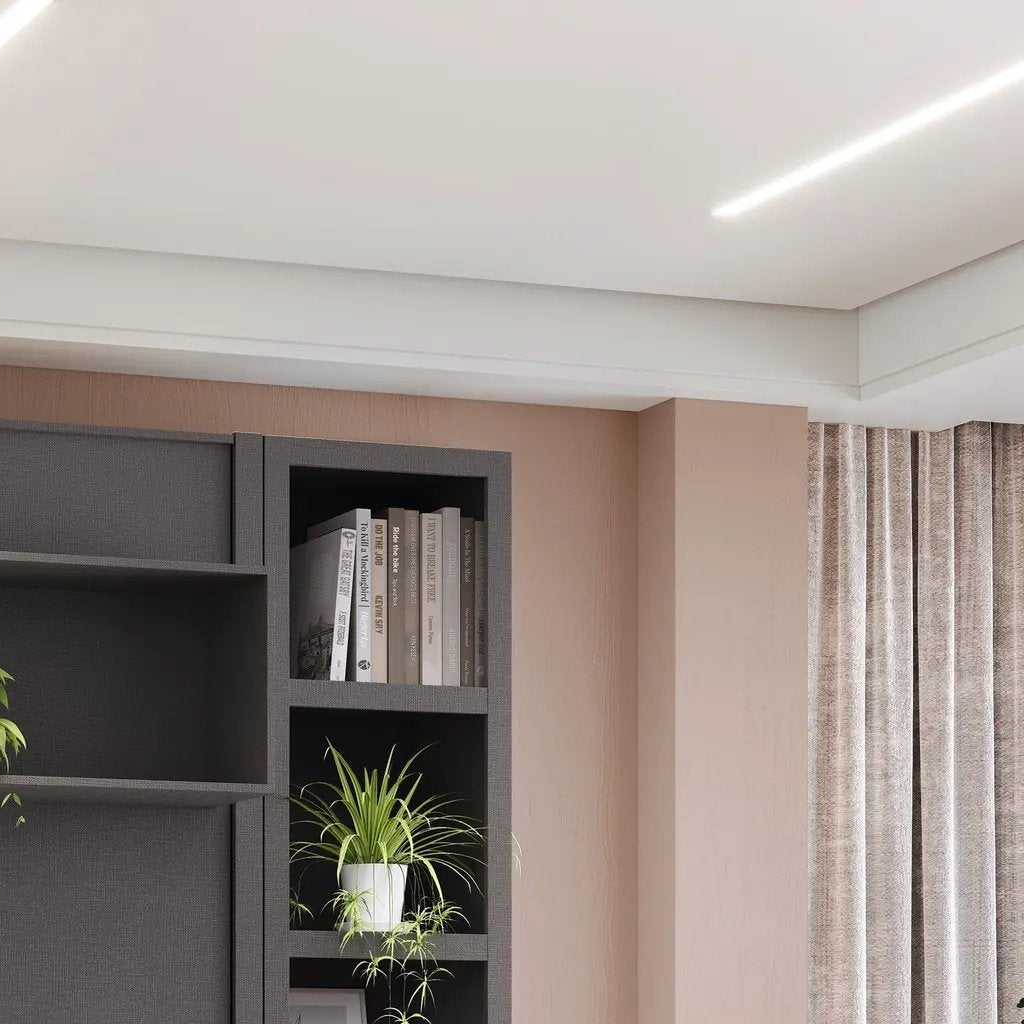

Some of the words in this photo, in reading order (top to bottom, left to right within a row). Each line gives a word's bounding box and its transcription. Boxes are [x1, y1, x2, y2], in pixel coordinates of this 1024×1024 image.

[360, 522, 369, 532] To
[375, 524, 383, 535] DO
[426, 522, 436, 541] WANT
[360, 534, 369, 547] Kill
[392, 527, 400, 543] Ride
[375, 536, 383, 550] THE
[392, 544, 400, 556] the
[426, 543, 436, 553] TO
[375, 551, 383, 566] JOB
[392, 558, 400, 573] bike
[358, 554, 369, 602] Mockingbird
[375, 595, 383, 618] KEVIN
[375, 619, 383, 634] SRY
